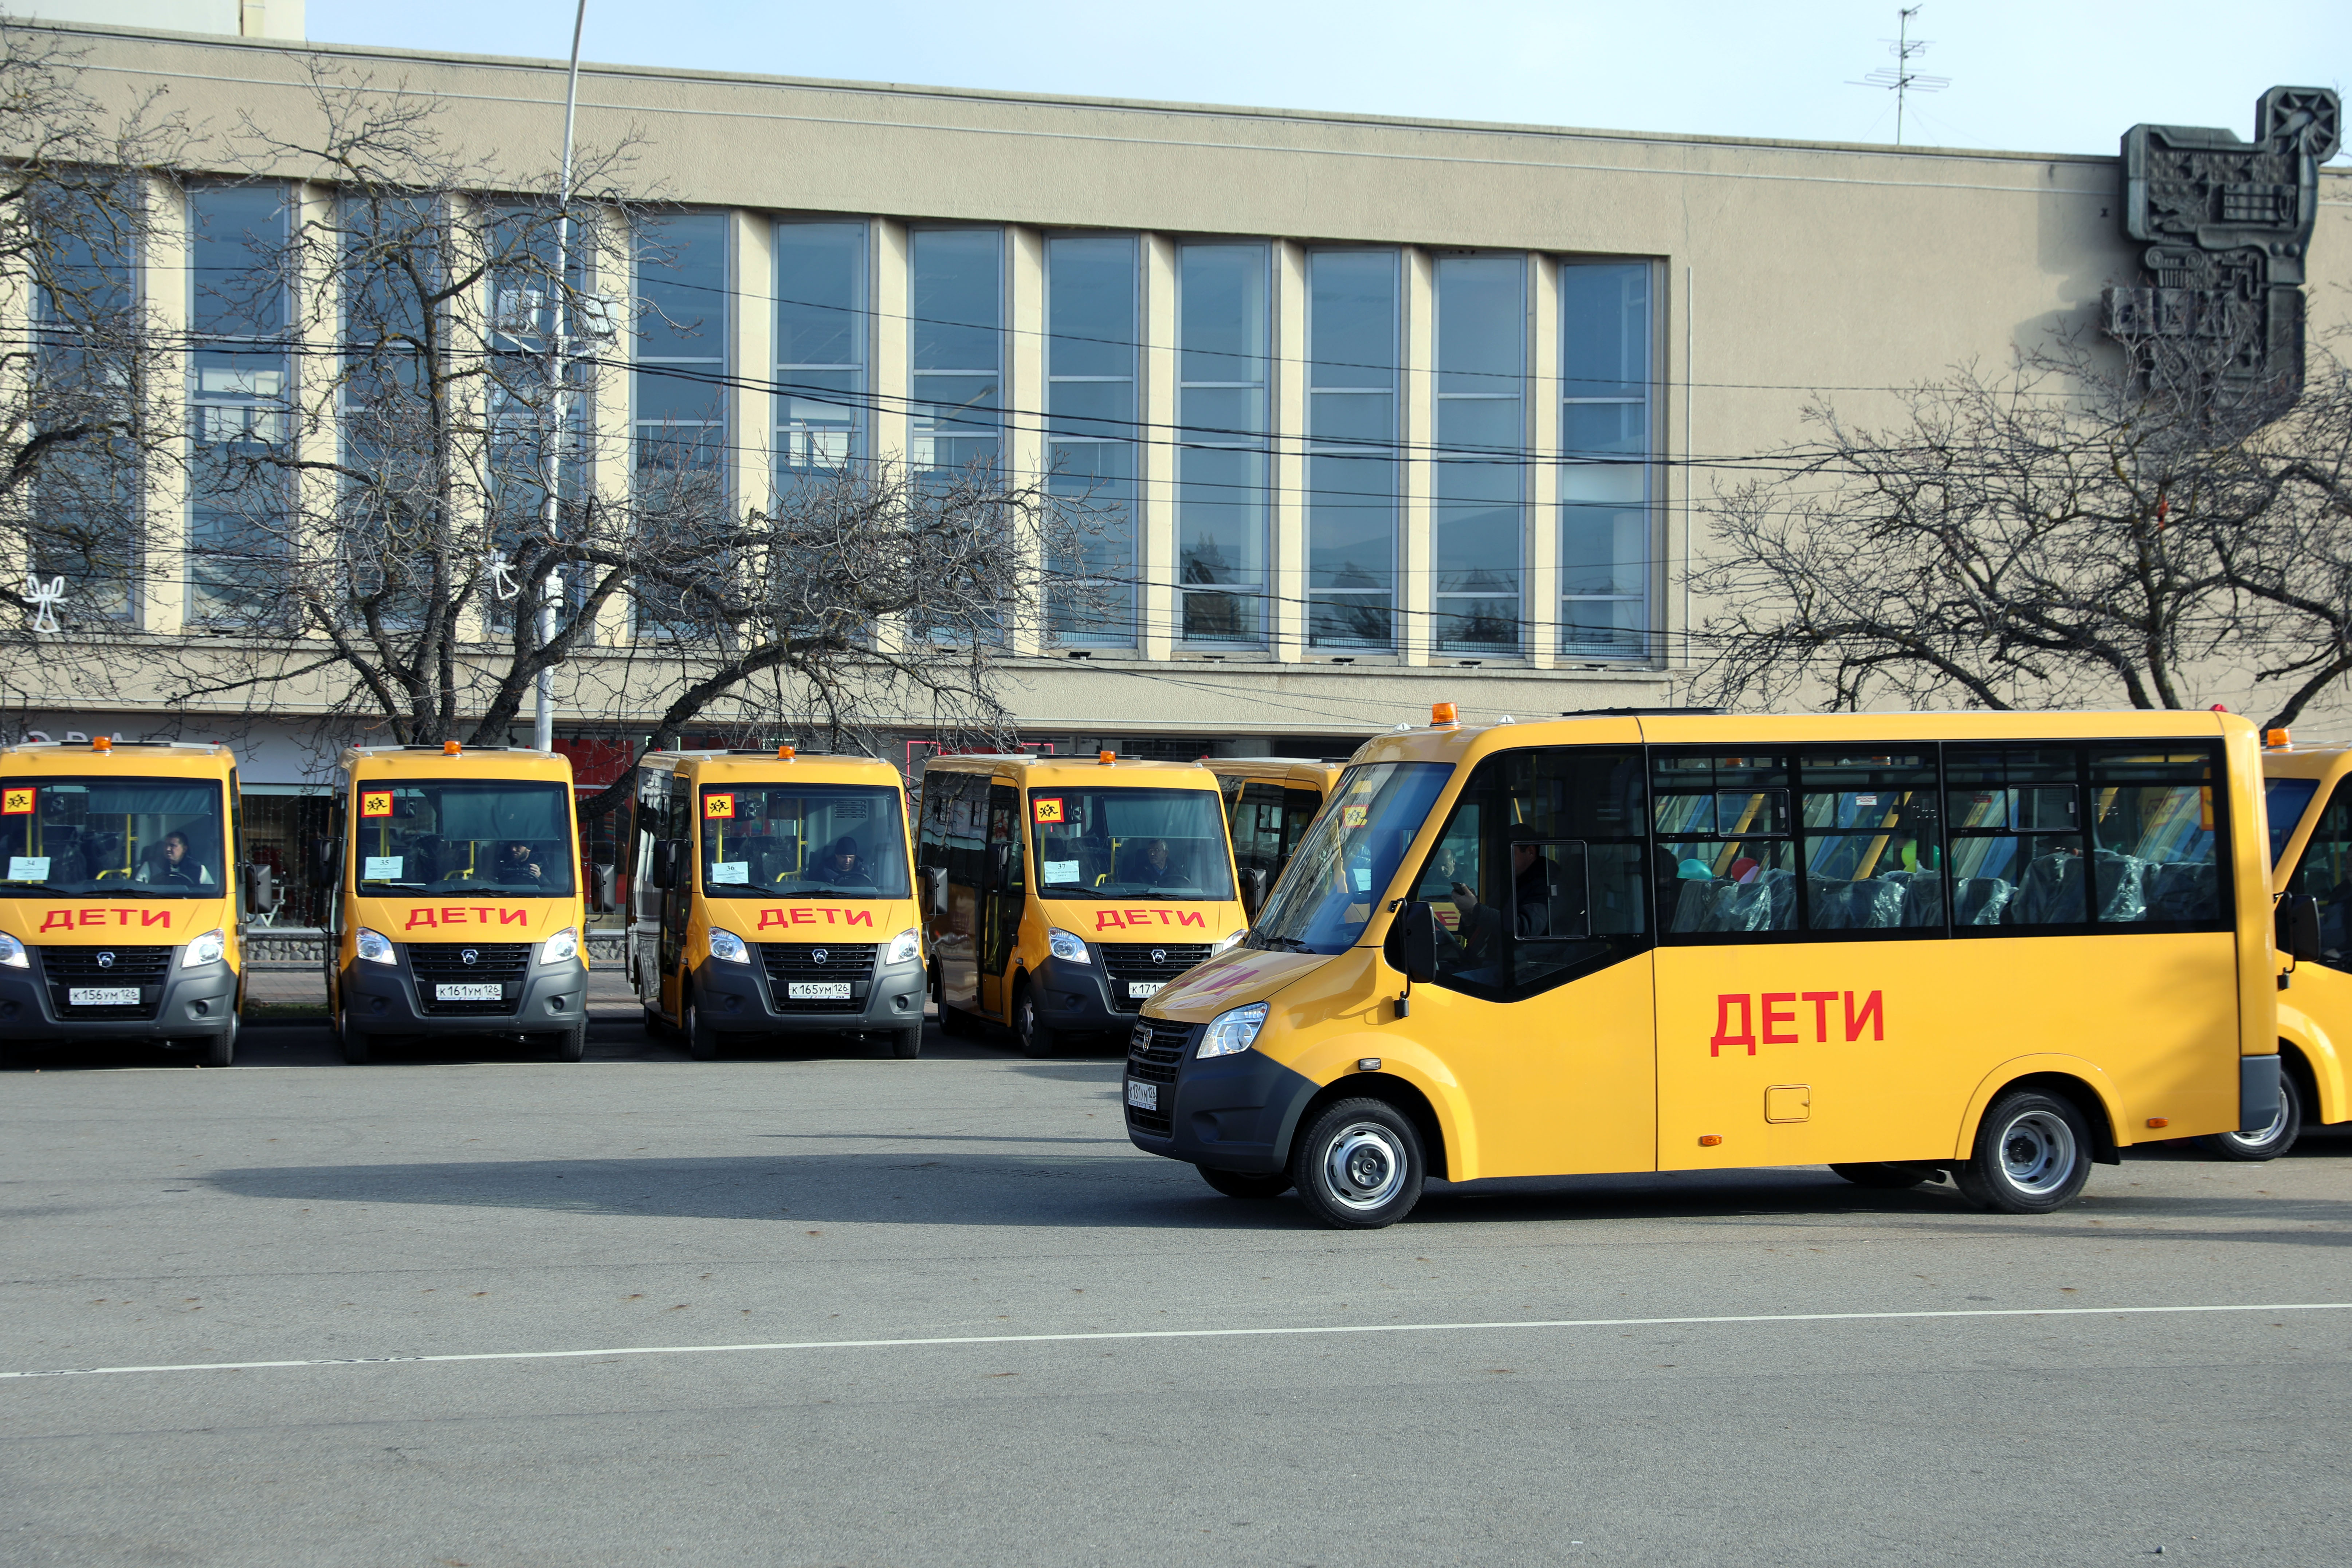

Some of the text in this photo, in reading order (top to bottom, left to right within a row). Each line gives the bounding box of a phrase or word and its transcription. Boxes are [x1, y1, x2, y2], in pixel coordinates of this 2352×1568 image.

[40, 909, 170, 933] ДЕТИ
[405, 907, 527, 931] ДЕТИ
[757, 908, 873, 931] ДЕТИ
[1095, 909, 1205, 931] ДЕТИ
[73, 990, 118, 1000] К156УМ
[440, 986, 481, 995] К161УМ
[792, 985, 831, 994] К165УМ
[1711, 990, 1884, 1057] ДЕТИ
[1130, 1084, 1147, 1101] К131УМ
